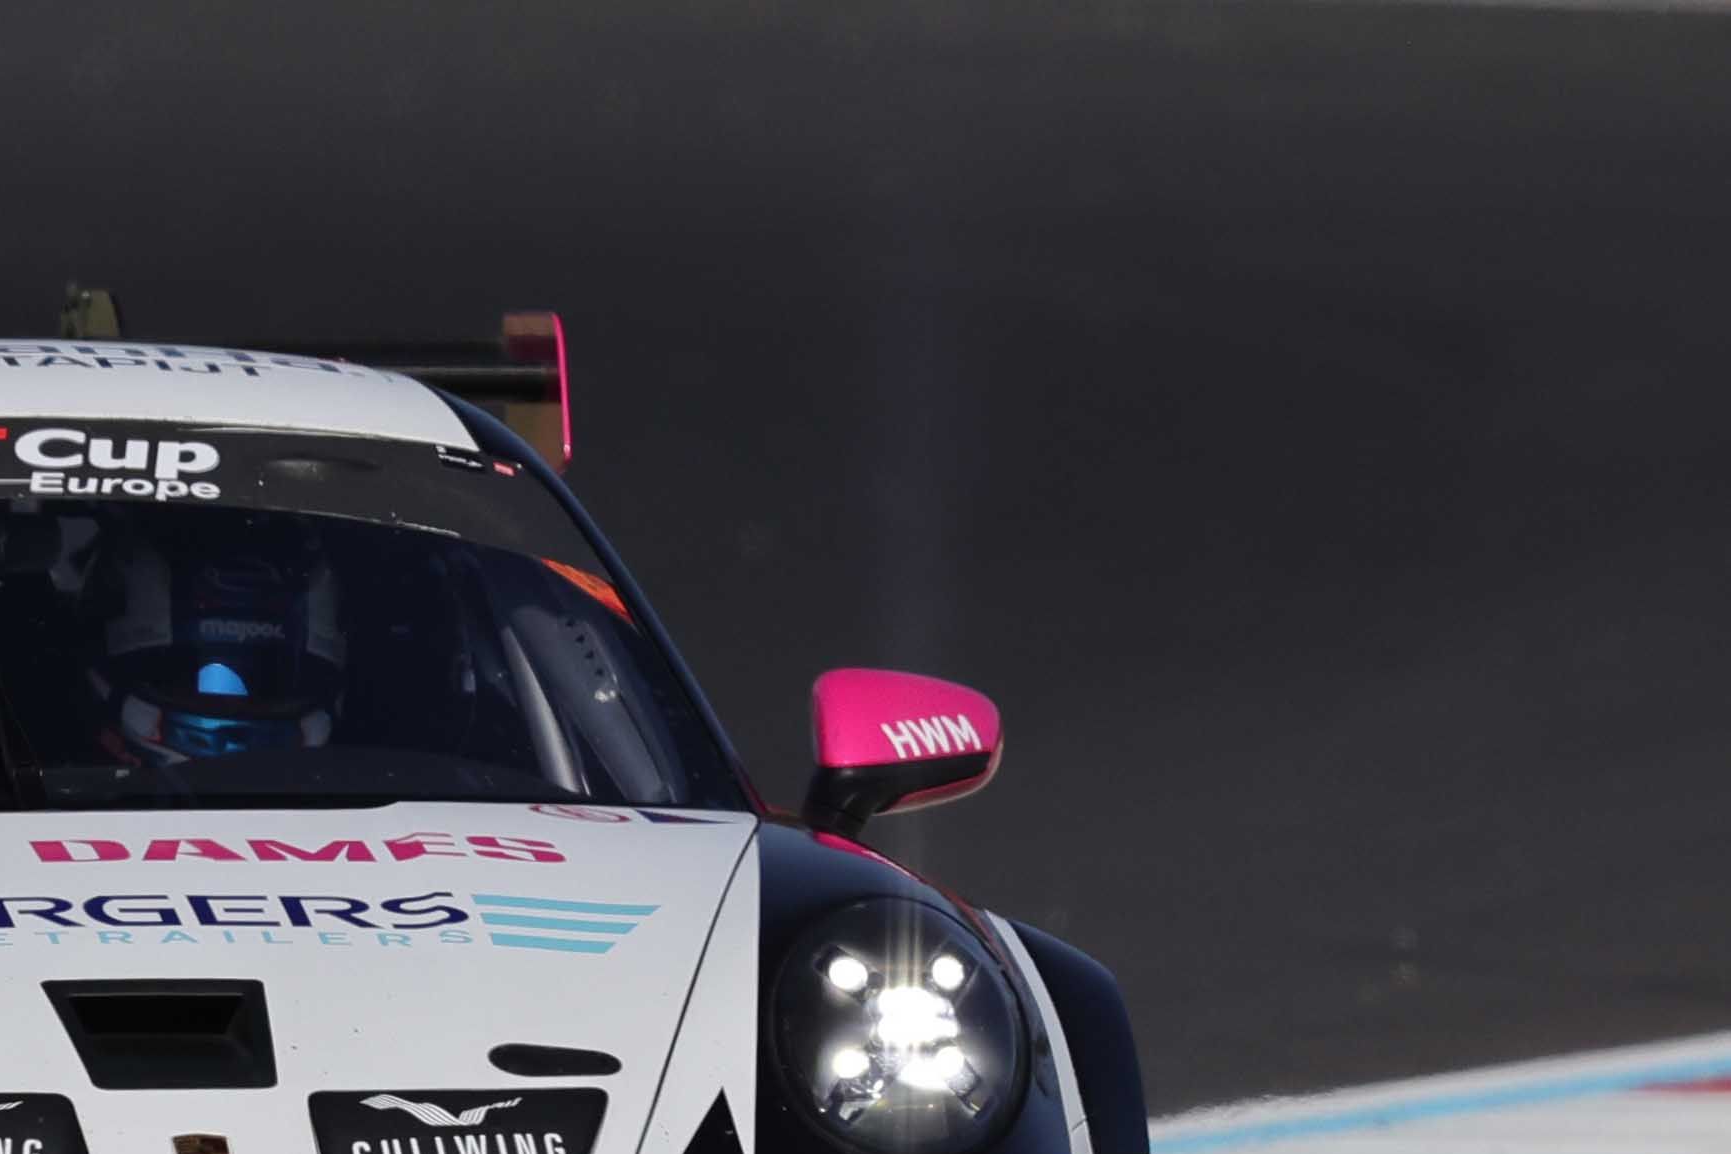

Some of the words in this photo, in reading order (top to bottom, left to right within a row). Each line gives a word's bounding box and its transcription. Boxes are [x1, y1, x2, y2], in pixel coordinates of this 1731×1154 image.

[15, 427, 220, 478] Cup
[30, 472, 221, 500] Europe
[880, 714, 982, 759] HWM
[39, 831, 568, 866] DAMES
